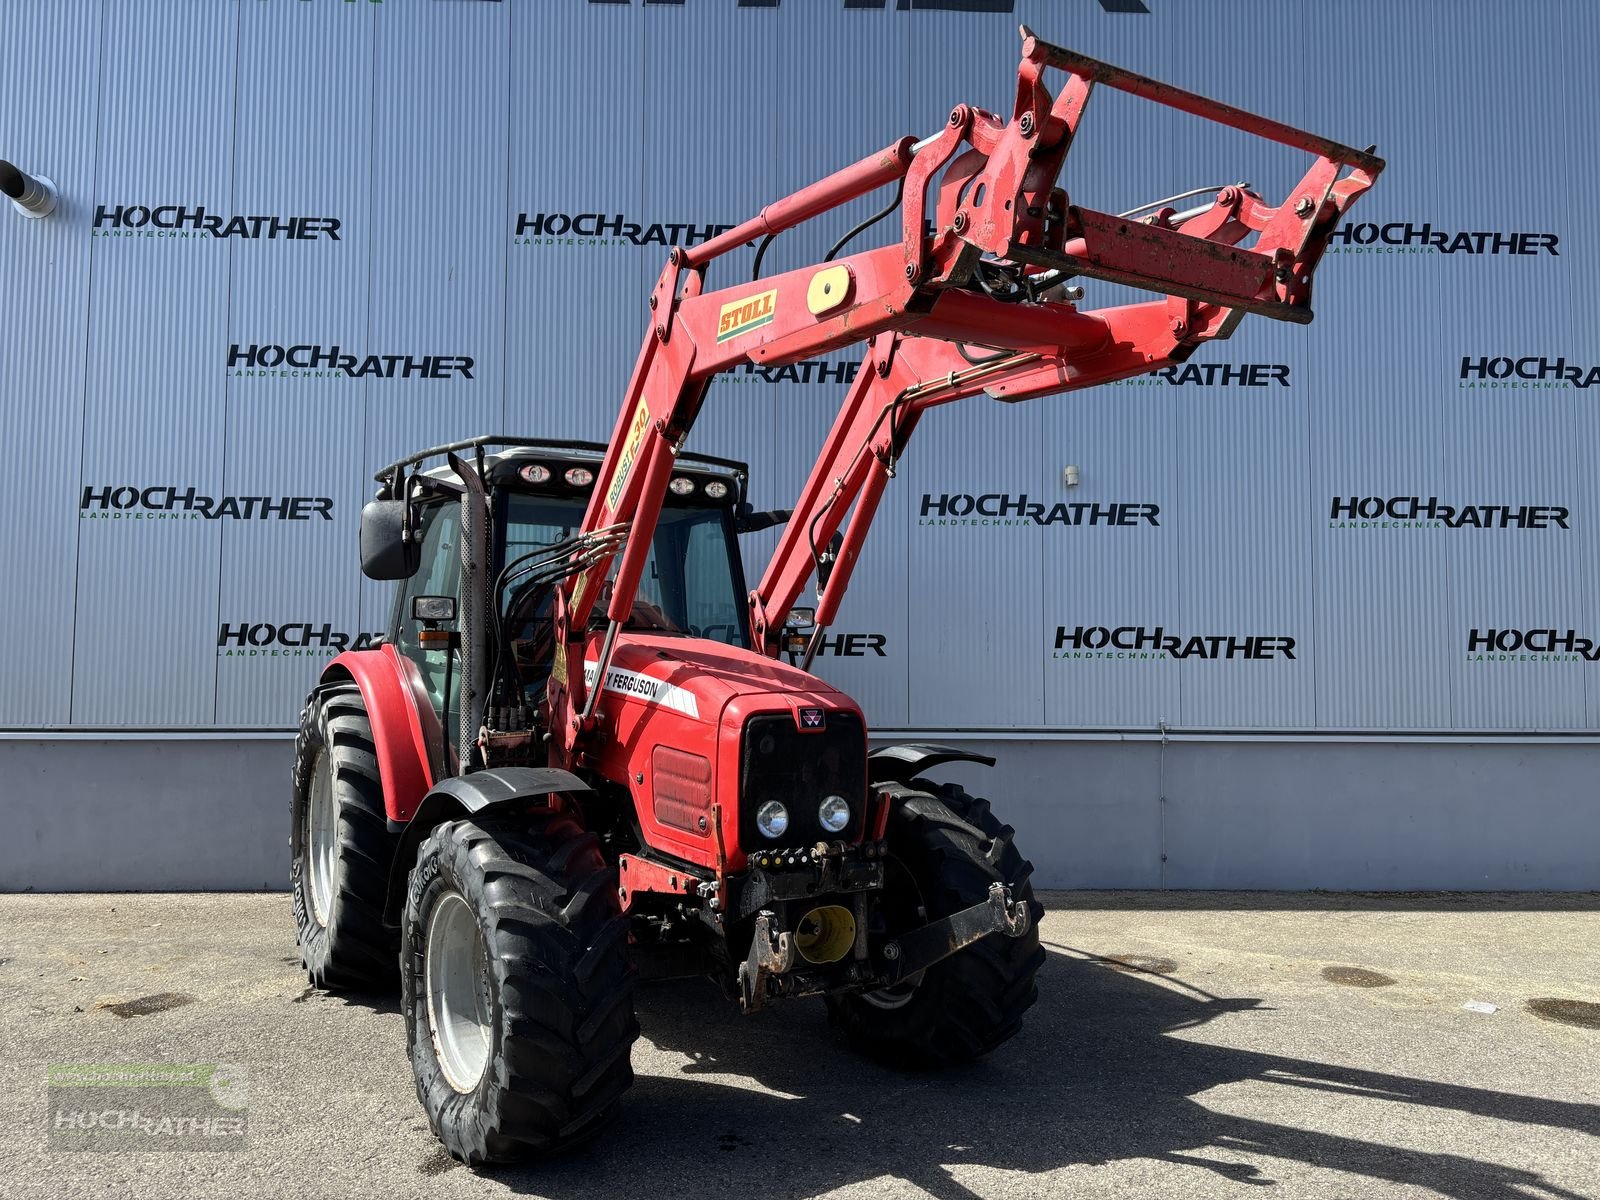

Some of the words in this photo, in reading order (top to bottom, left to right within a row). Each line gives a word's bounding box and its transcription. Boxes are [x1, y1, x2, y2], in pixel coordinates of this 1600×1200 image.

[93, 229, 208, 239] LANDTECHNIK
[94, 205, 341, 241] HOCHRATHER
[515, 213, 756, 248] HOCHRATH
[1329, 223, 1560, 256] HOCHRATHER
[514, 238, 627, 246] LANDTECHNIK
[720, 294, 774, 334] STOLL
[226, 371, 343, 379] LANDTECHNIK
[227, 344, 474, 379] HOCHRATHER
[1150, 364, 1290, 387] RATHER
[609, 450, 630, 503] ROBUST
[80, 486, 334, 521] HOCHRATHER
[80, 512, 199, 520] LANDTECHNIK
[920, 494, 1160, 527] HOCHRATHER
[1331, 496, 1570, 529] HOCHRATHER
[218, 624, 385, 652] HOCHRA
[1055, 626, 1296, 659] HOCHRATHER
[1053, 651, 1167, 659] LANDTECHNIK
[1466, 654, 1579, 662] LANDTECHNIK
[612, 673, 659, 698] FERGUSON
